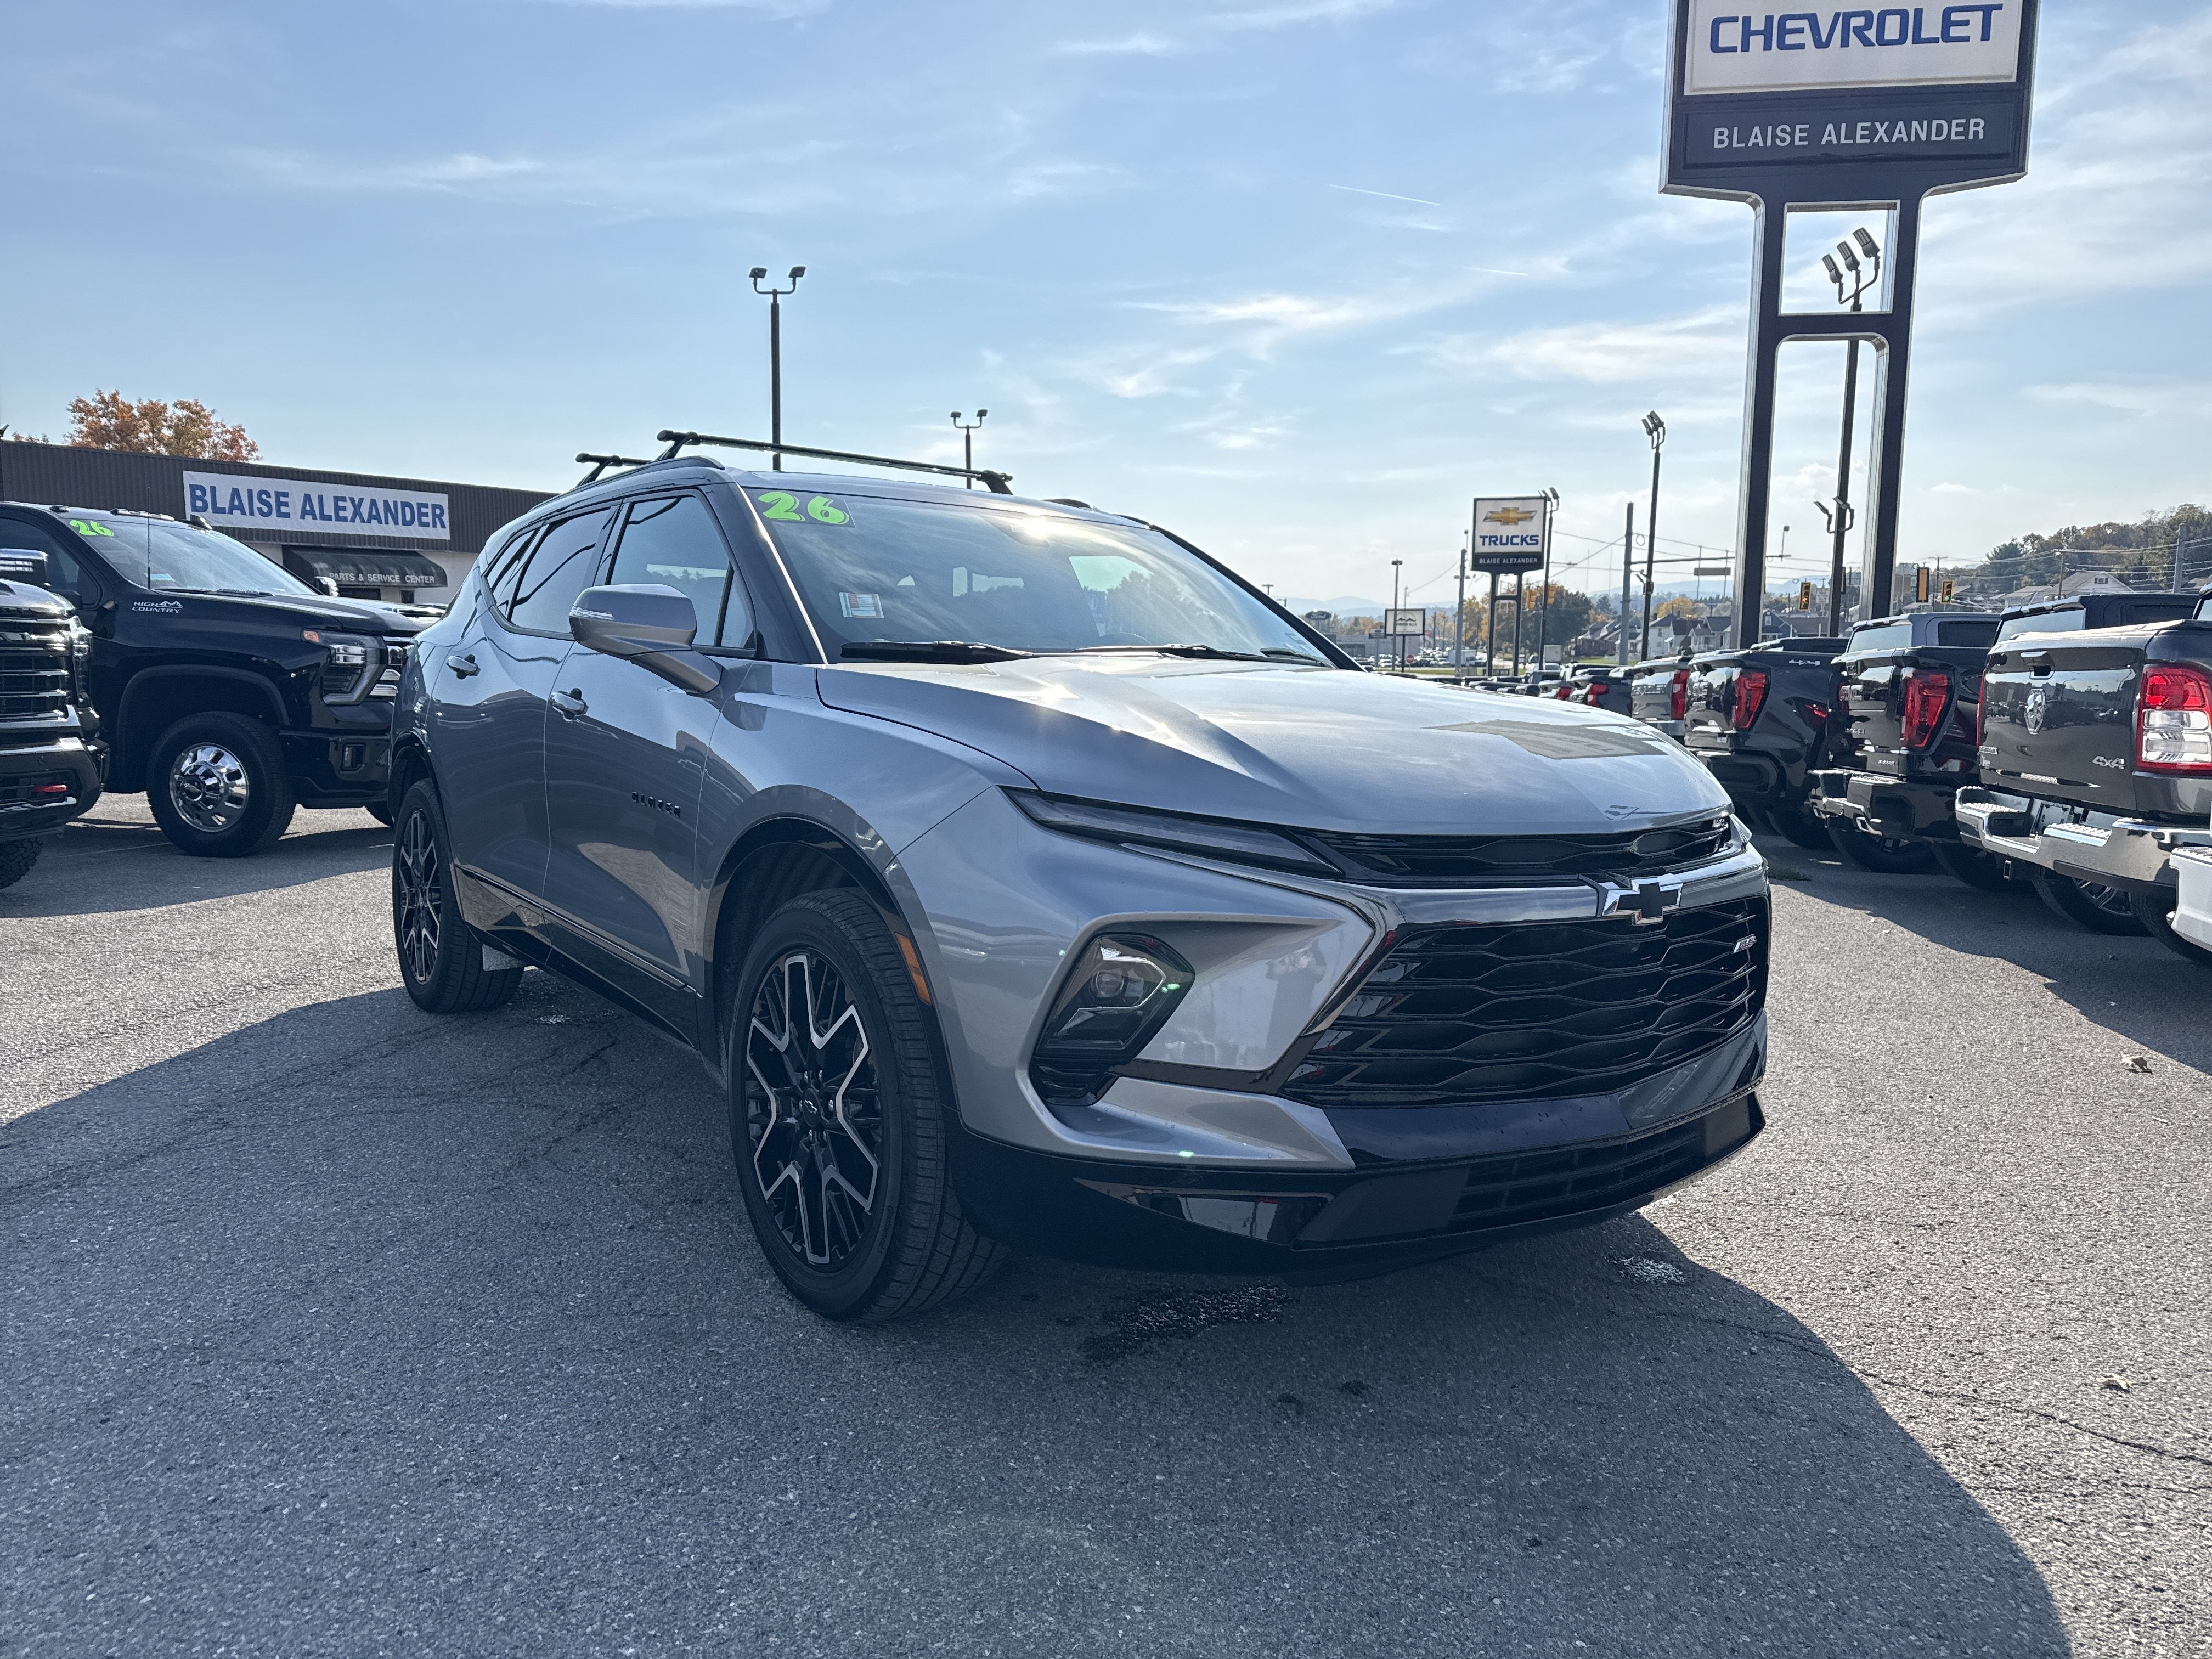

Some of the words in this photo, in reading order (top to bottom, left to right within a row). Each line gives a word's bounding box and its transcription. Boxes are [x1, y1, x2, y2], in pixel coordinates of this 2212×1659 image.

[1710, 3, 2004, 53] CHEVROLET
[1713, 124, 1810, 148] BLAISE
[1821, 118, 1985, 145] ALEXANDER
[189, 483, 291, 518] BLAISE
[300, 493, 447, 529] ALEXANDER
[758, 491, 850, 525] 26
[69, 520, 114, 537] 26
[1479, 534, 1539, 546] TRUCKS
[329, 572, 356, 582] PARTS
[358, 573, 364, 582] &
[367, 573, 401, 583] SERVICE
[405, 575, 435, 583] CENTER
